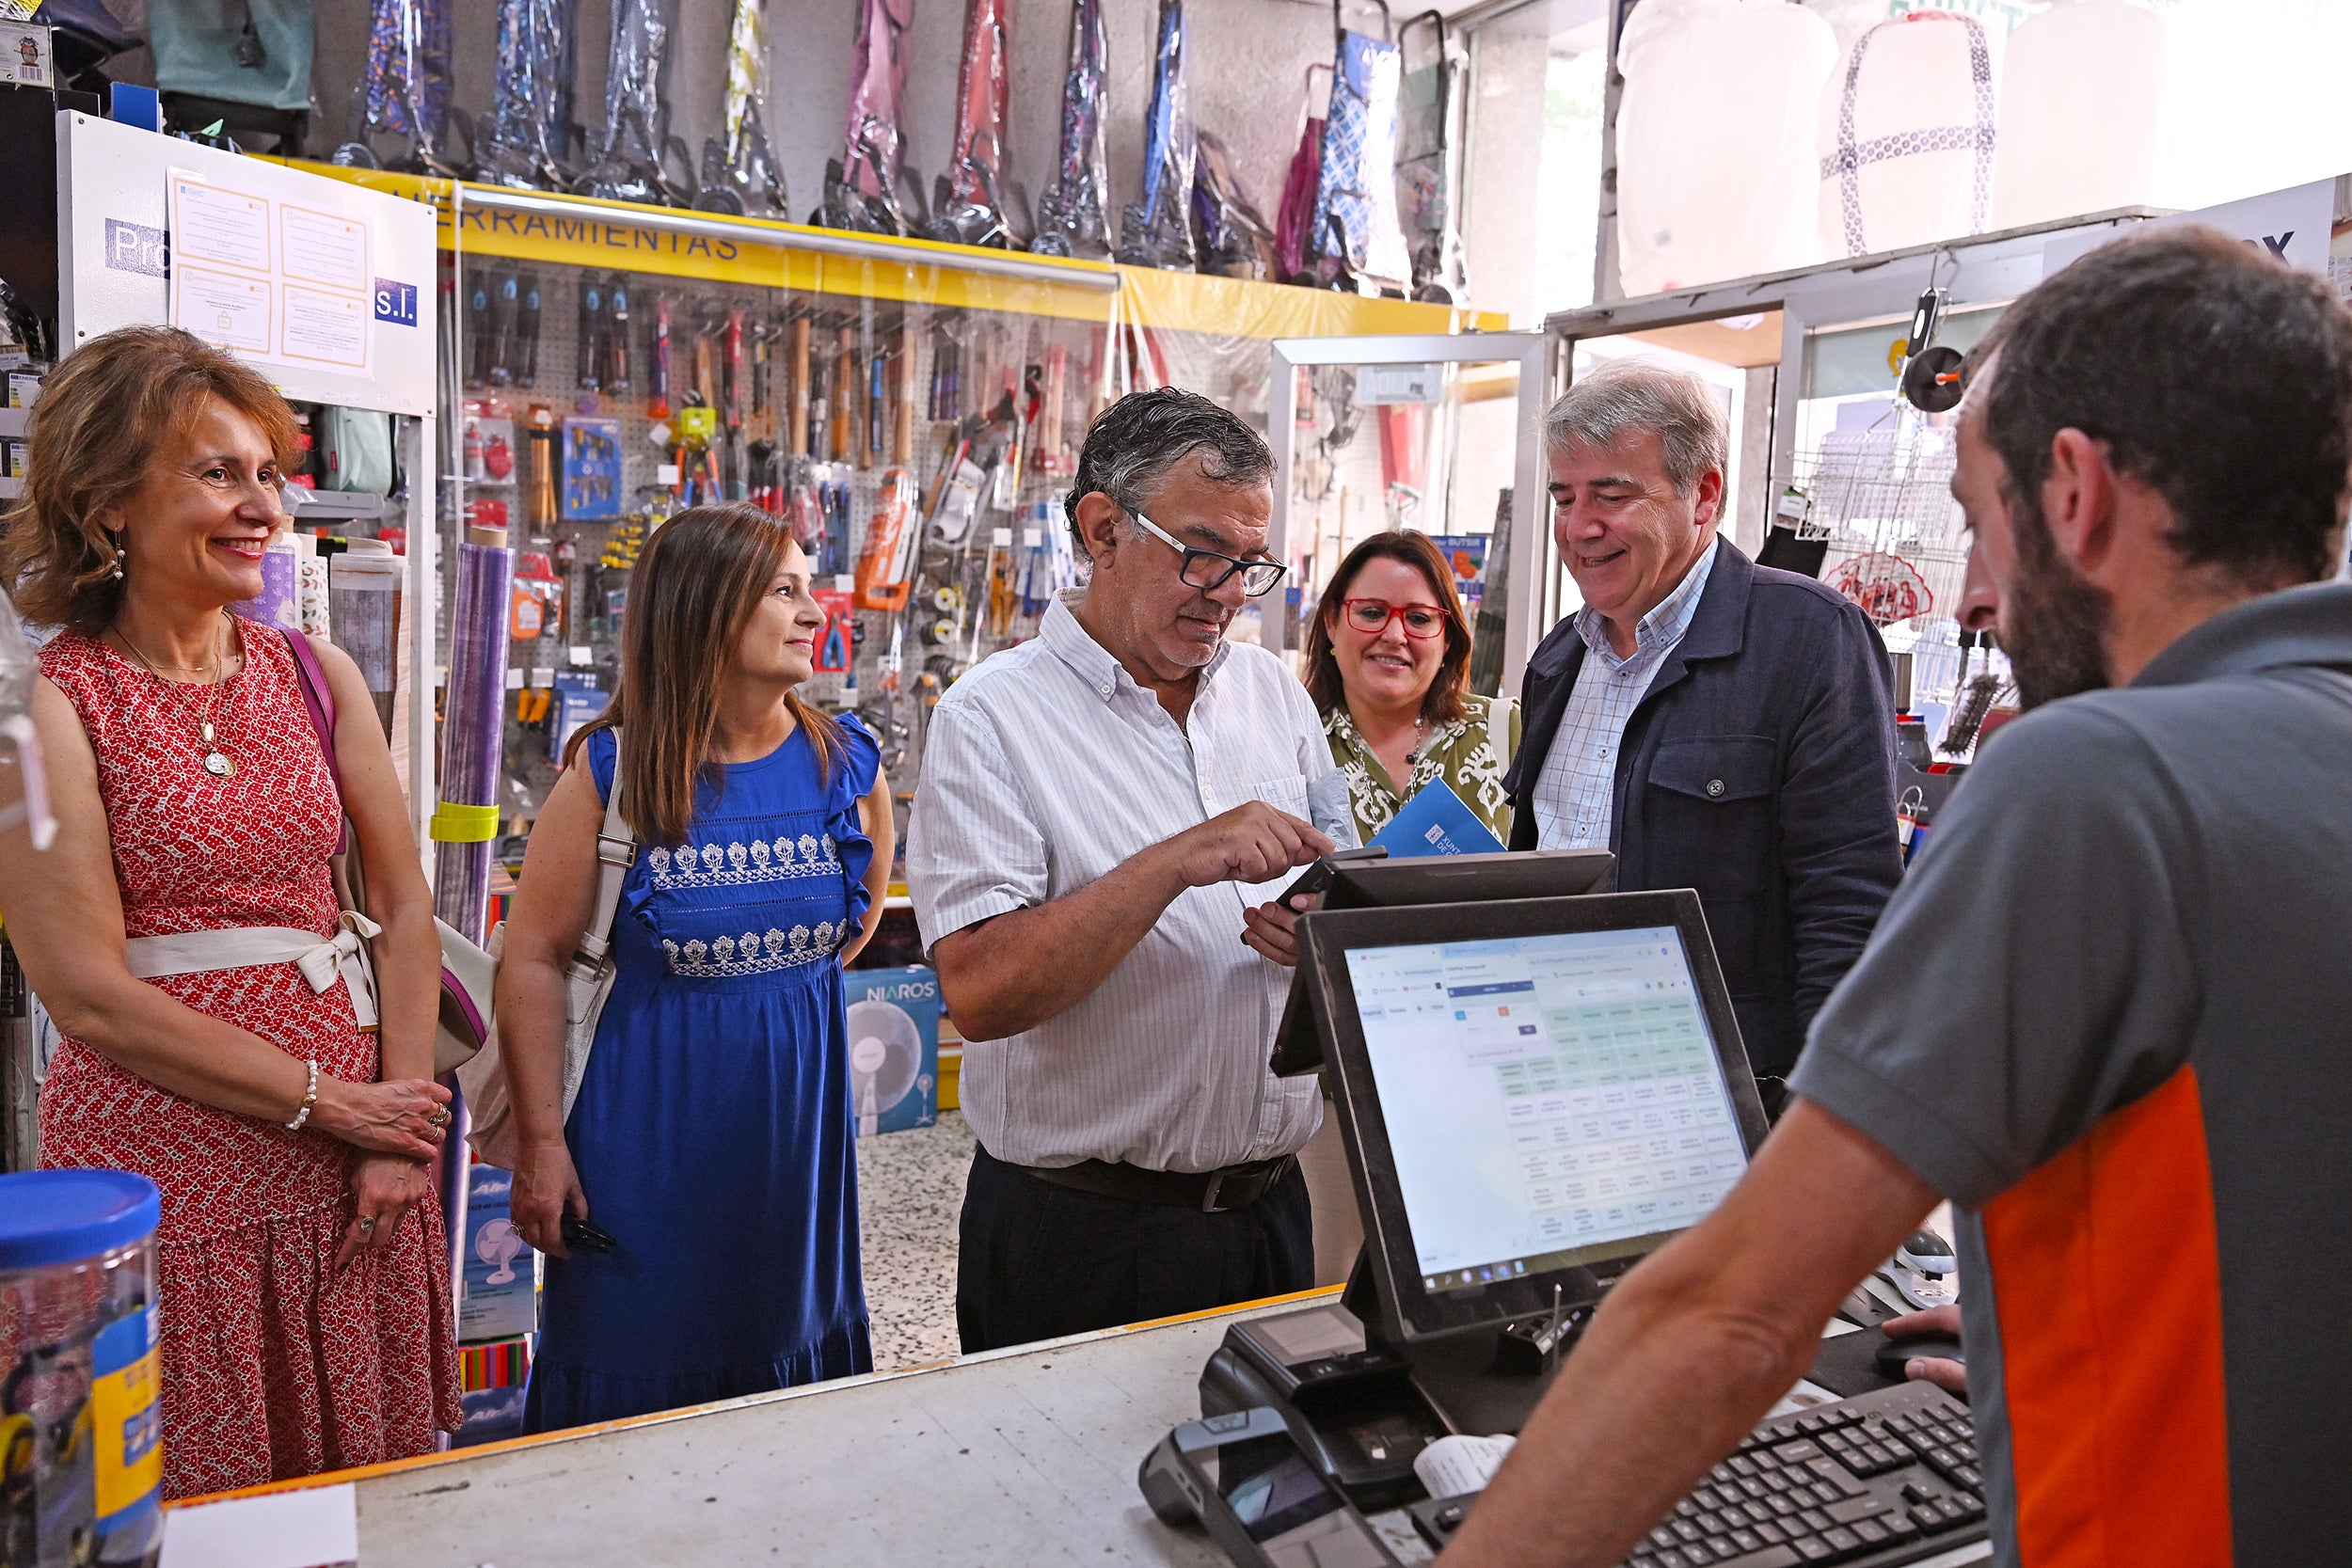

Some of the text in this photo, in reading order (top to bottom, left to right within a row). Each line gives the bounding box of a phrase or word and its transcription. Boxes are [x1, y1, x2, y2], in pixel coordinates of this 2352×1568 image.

[393, 190, 738, 261] ERRAMIENAS
[376, 287, 414, 320] s.l.
[1442, 836, 1464, 857] XUNT
[866, 981, 935, 1002] NIAROS
